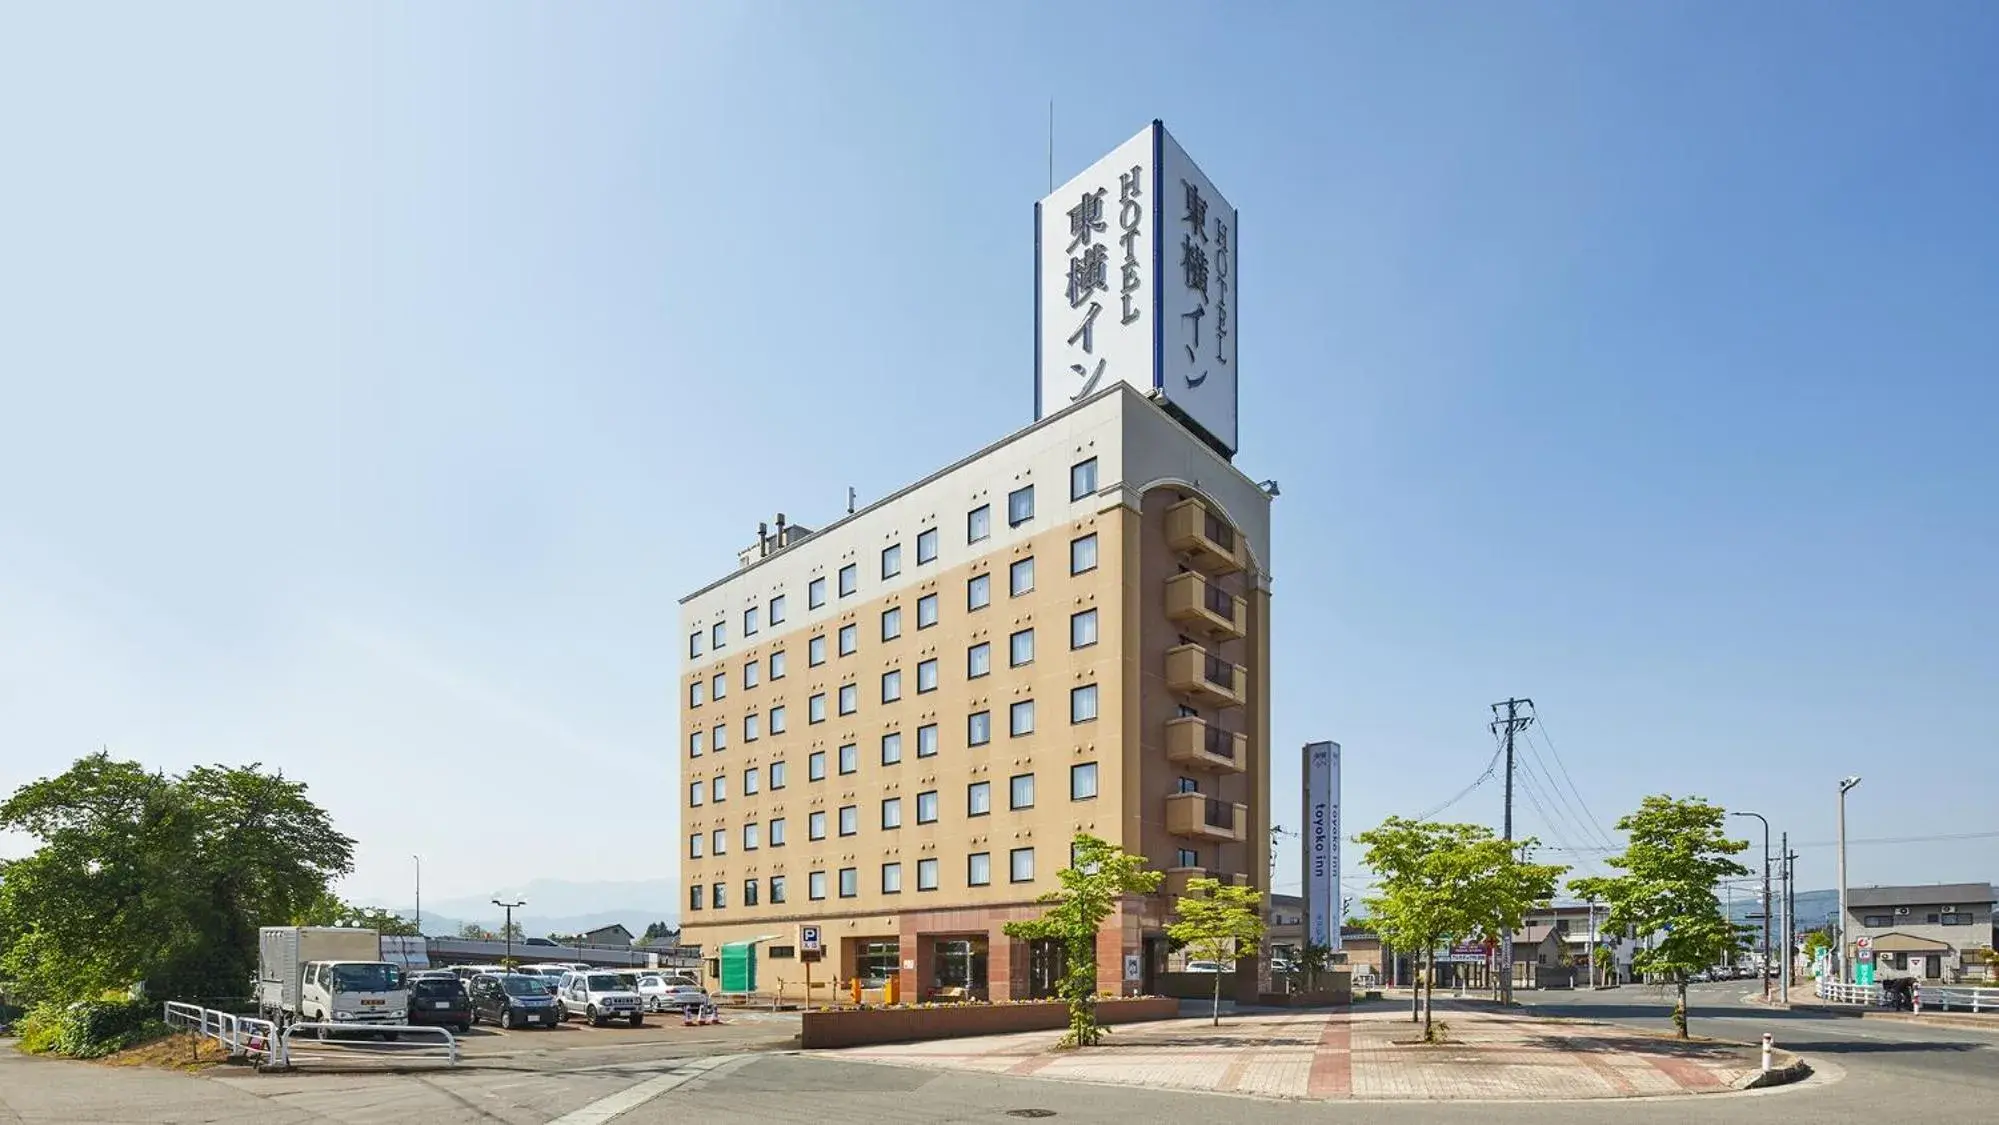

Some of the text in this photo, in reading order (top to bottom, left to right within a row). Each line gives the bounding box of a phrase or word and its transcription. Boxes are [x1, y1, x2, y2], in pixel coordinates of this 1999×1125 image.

[1066, 187, 1108, 401] 東横イン
[1119, 164, 1142, 326] HOTEL
[1180, 178, 1209, 389] 東横イン
[1214, 217, 1228, 365] HOTEL
[1313, 804, 1326, 877] toyoko inn
[805, 929, 816, 941] P
